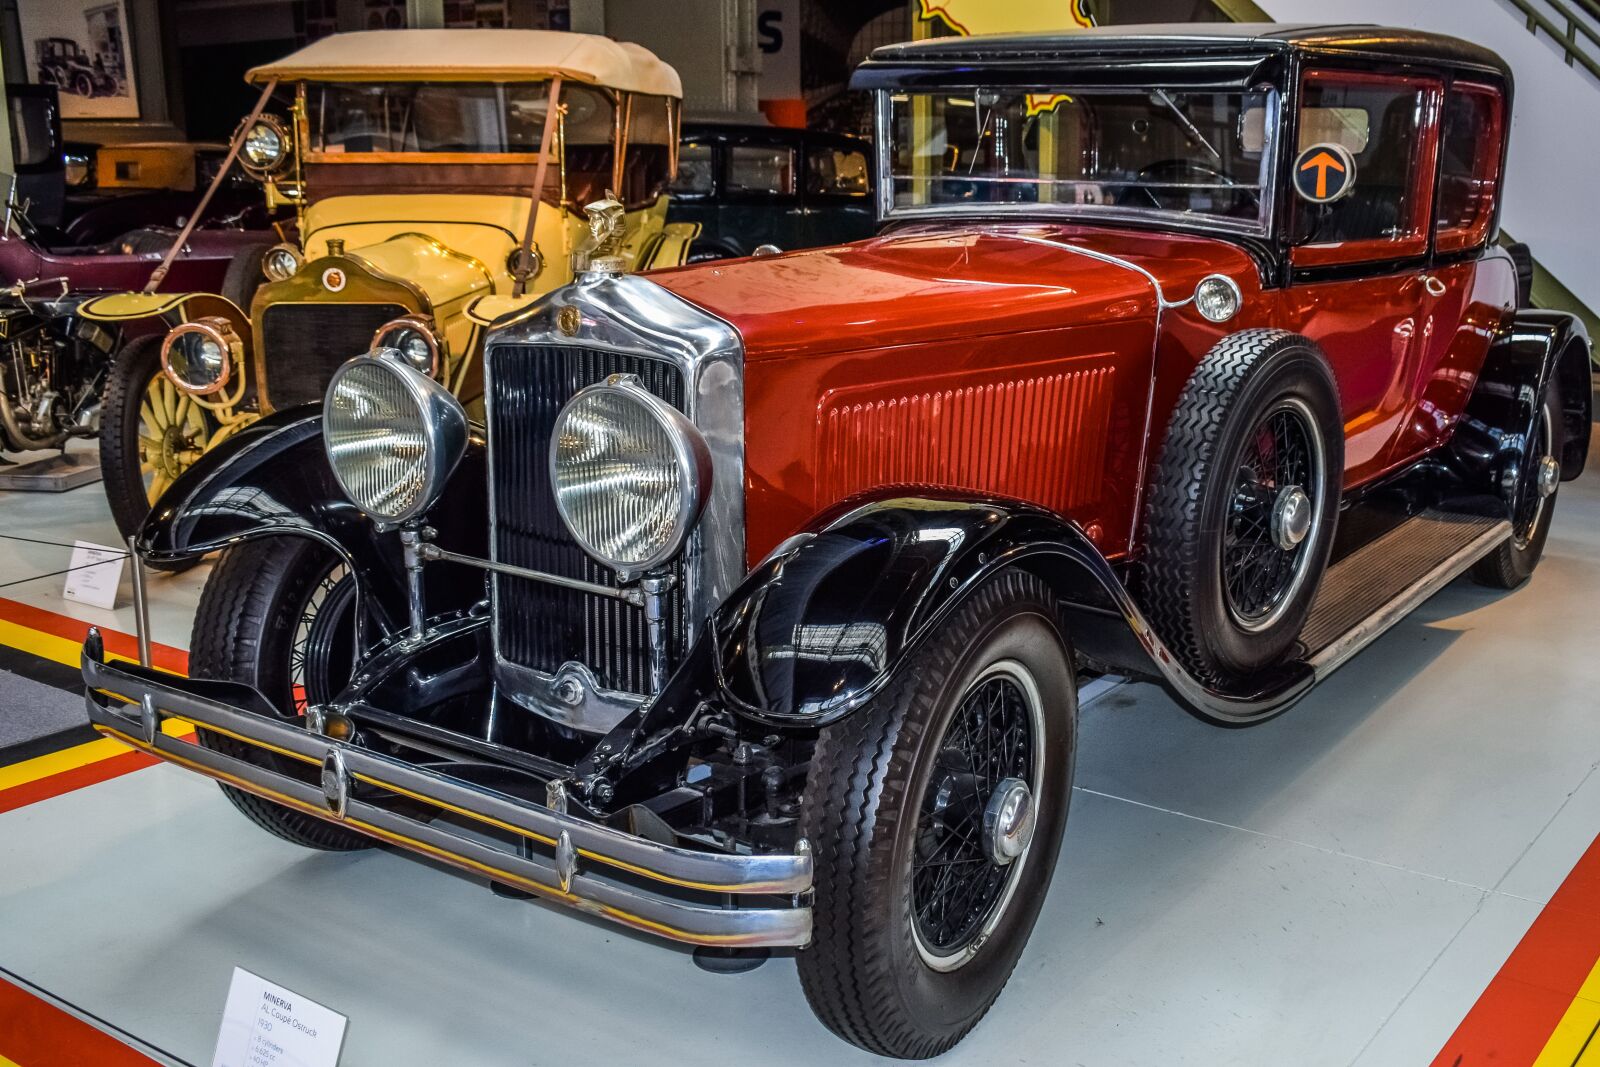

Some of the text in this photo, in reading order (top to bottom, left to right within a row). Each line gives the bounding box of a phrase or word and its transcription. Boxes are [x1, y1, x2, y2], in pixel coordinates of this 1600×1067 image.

[757, 10, 783, 54] S
[263, 991, 292, 1012] MINERVA
[257, 1017, 273, 1032] 1930
[261, 1003, 317, 1039] AL Coupé Ostruck
